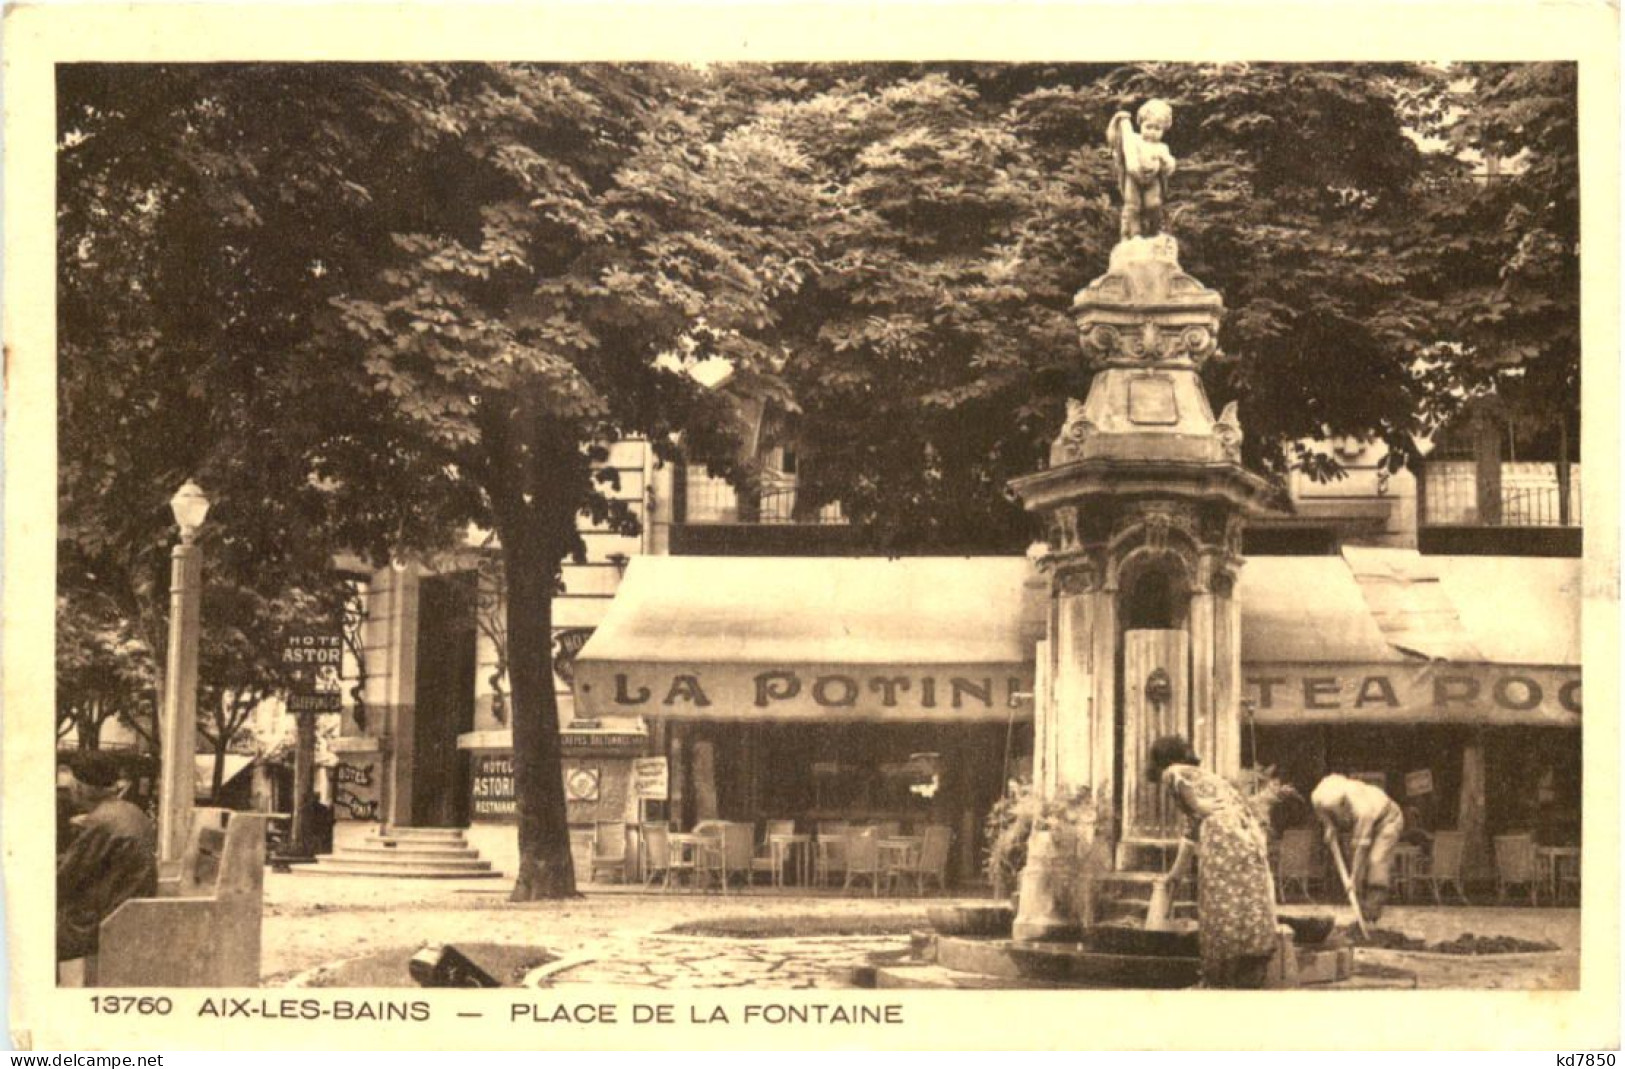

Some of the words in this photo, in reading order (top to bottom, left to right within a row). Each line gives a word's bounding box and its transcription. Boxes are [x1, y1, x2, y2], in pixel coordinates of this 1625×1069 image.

[282, 648, 340, 663] ASTOR
[613, 673, 712, 707] LA
[1246, 676, 1400, 710] TEA
[483, 760, 514, 774] HOTEL
